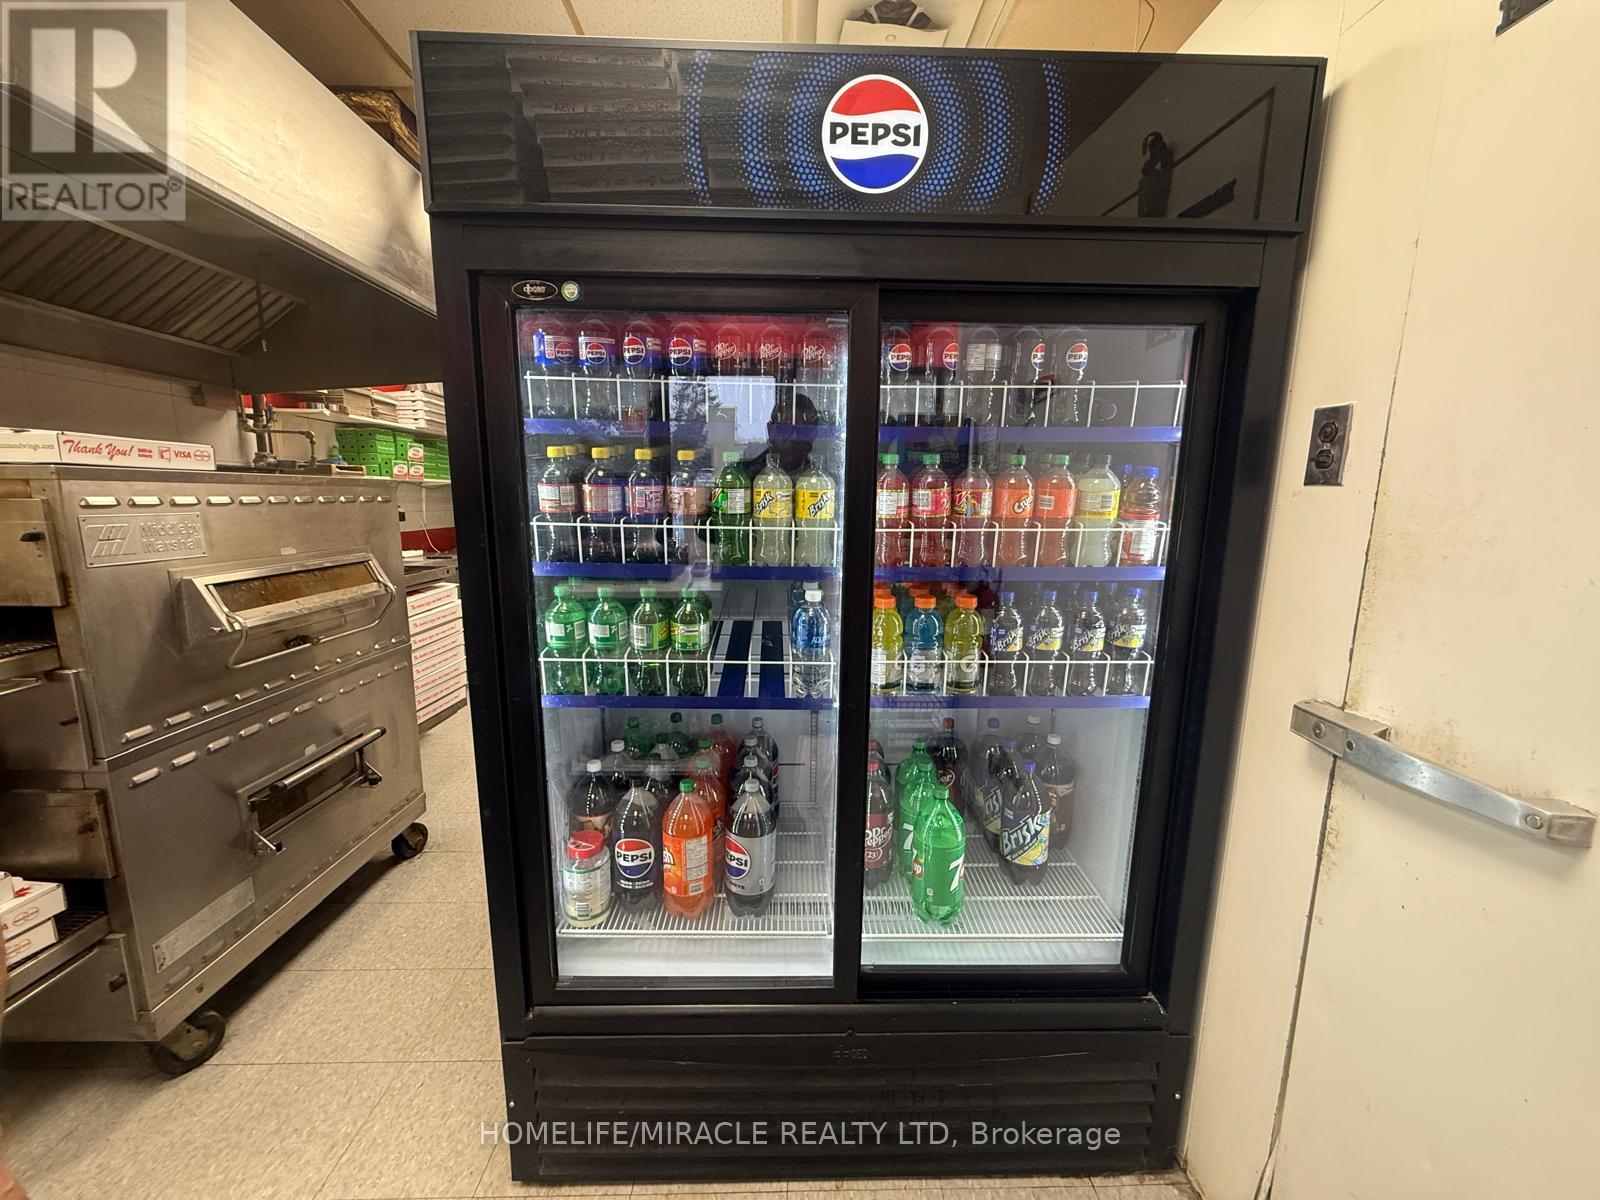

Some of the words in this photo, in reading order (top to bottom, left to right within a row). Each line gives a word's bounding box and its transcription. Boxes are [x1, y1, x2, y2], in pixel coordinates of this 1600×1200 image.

[829, 121, 921, 147] PEPSI
[63, 439, 103, 454] Thank
[105, 443, 134, 461] You!
[173, 450, 192, 459] VISA
[872, 826, 886, 838] Dr
[902, 822, 914, 850] 7
[1001, 813, 1043, 857] Brisk
[616, 851, 652, 863] PEPSI
